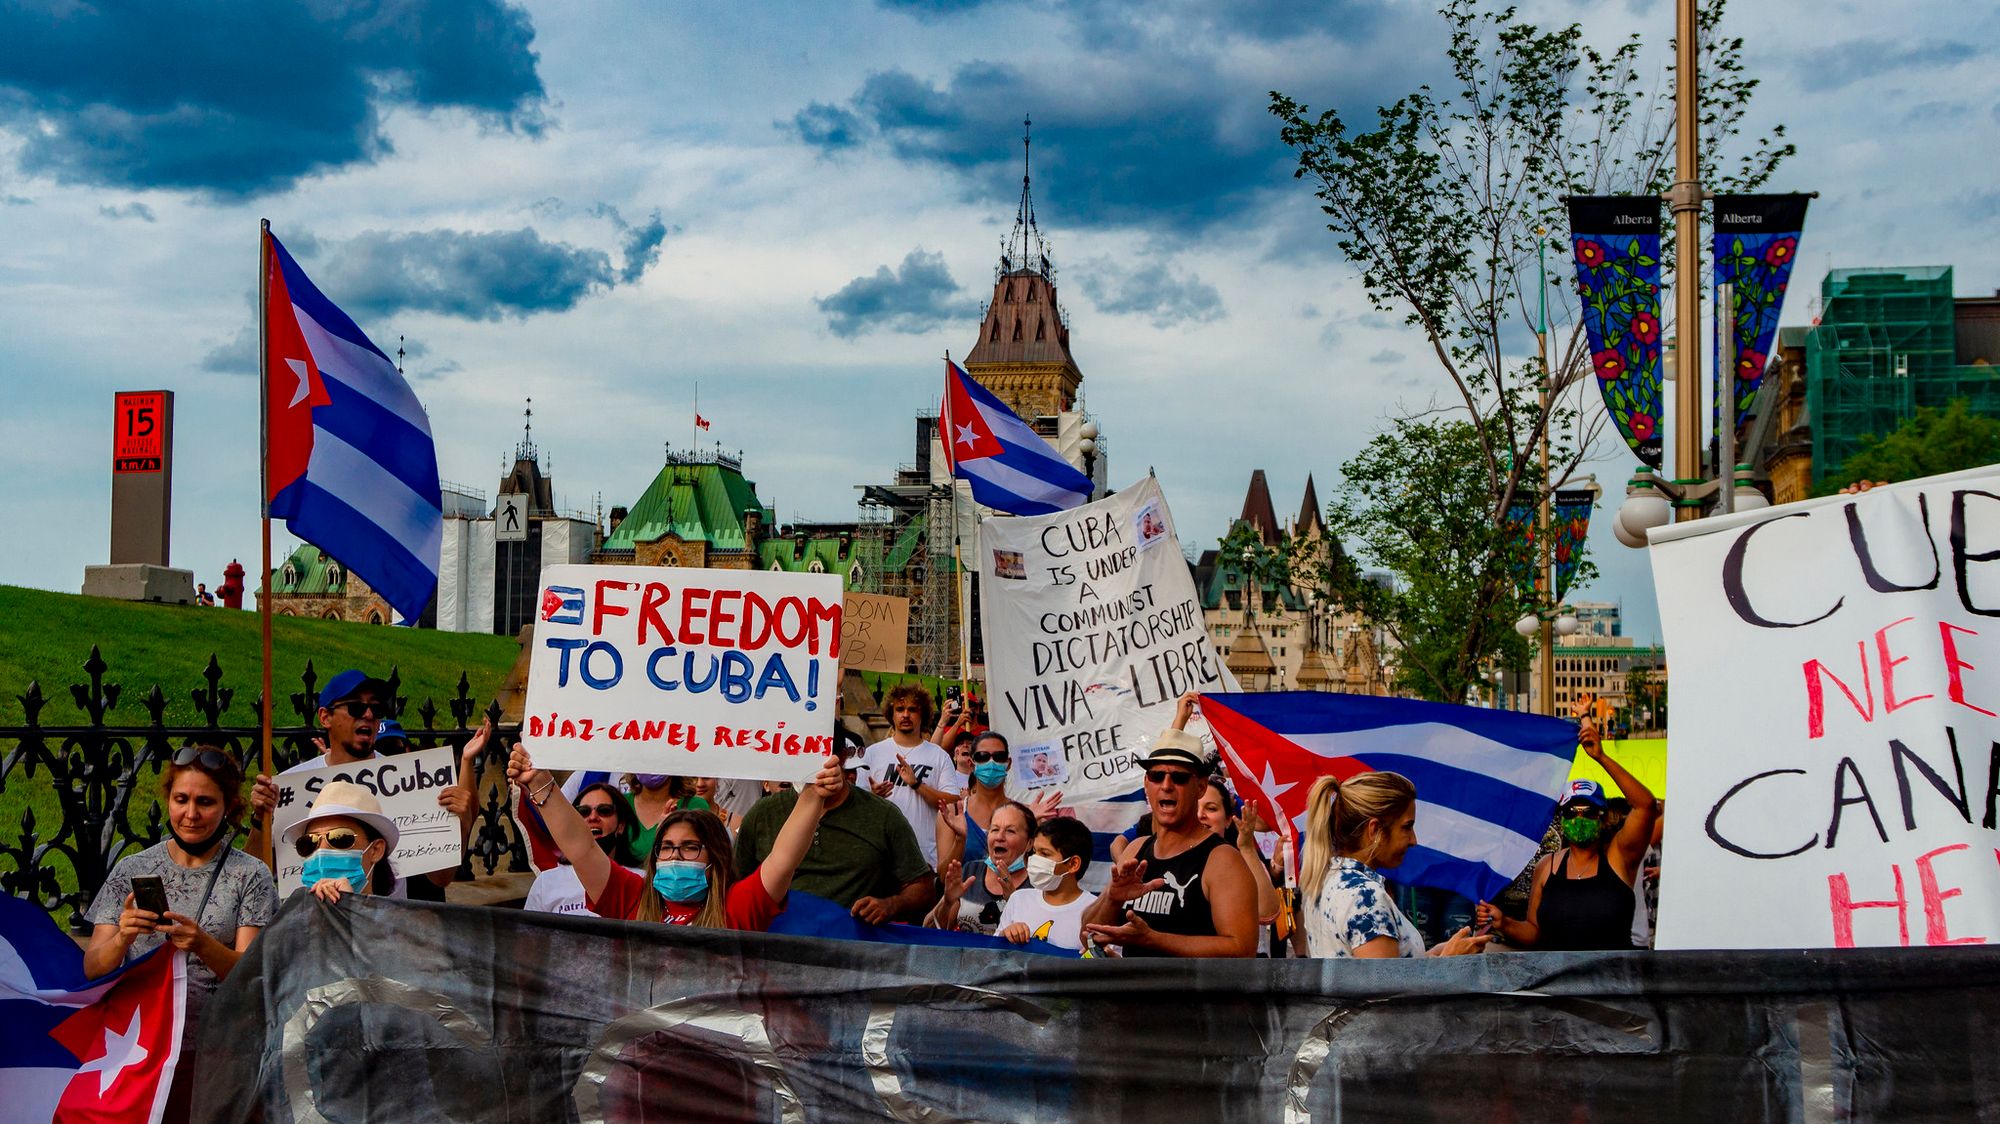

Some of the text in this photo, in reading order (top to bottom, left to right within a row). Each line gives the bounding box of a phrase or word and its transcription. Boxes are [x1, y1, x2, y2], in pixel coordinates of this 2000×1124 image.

[1613, 214, 1653, 225] Alberta
[1722, 213, 1763, 224] Alberta
[127, 408, 155, 437] 15
[121, 459, 155, 470] km/h
[1041, 512, 1122, 557] CUBA
[1046, 546, 1137, 586] IS UNDER
[1079, 582, 1099, 604] A
[592, 579, 842, 658] FREEDOM
[844, 598, 895, 625] DOM
[1040, 584, 1155, 634] COMMUNIST
[841, 620, 871, 640] OR
[1032, 599, 1196, 677] DICTATORSHIP
[842, 640, 888, 669] BA
[546, 637, 819, 712] TO CUBA!
[1005, 636, 1218, 731] VIVA LIBRE
[1061, 723, 1127, 762] FREE
[883, 763, 933, 787] NKE
[1083, 751, 1143, 780] CUBA
